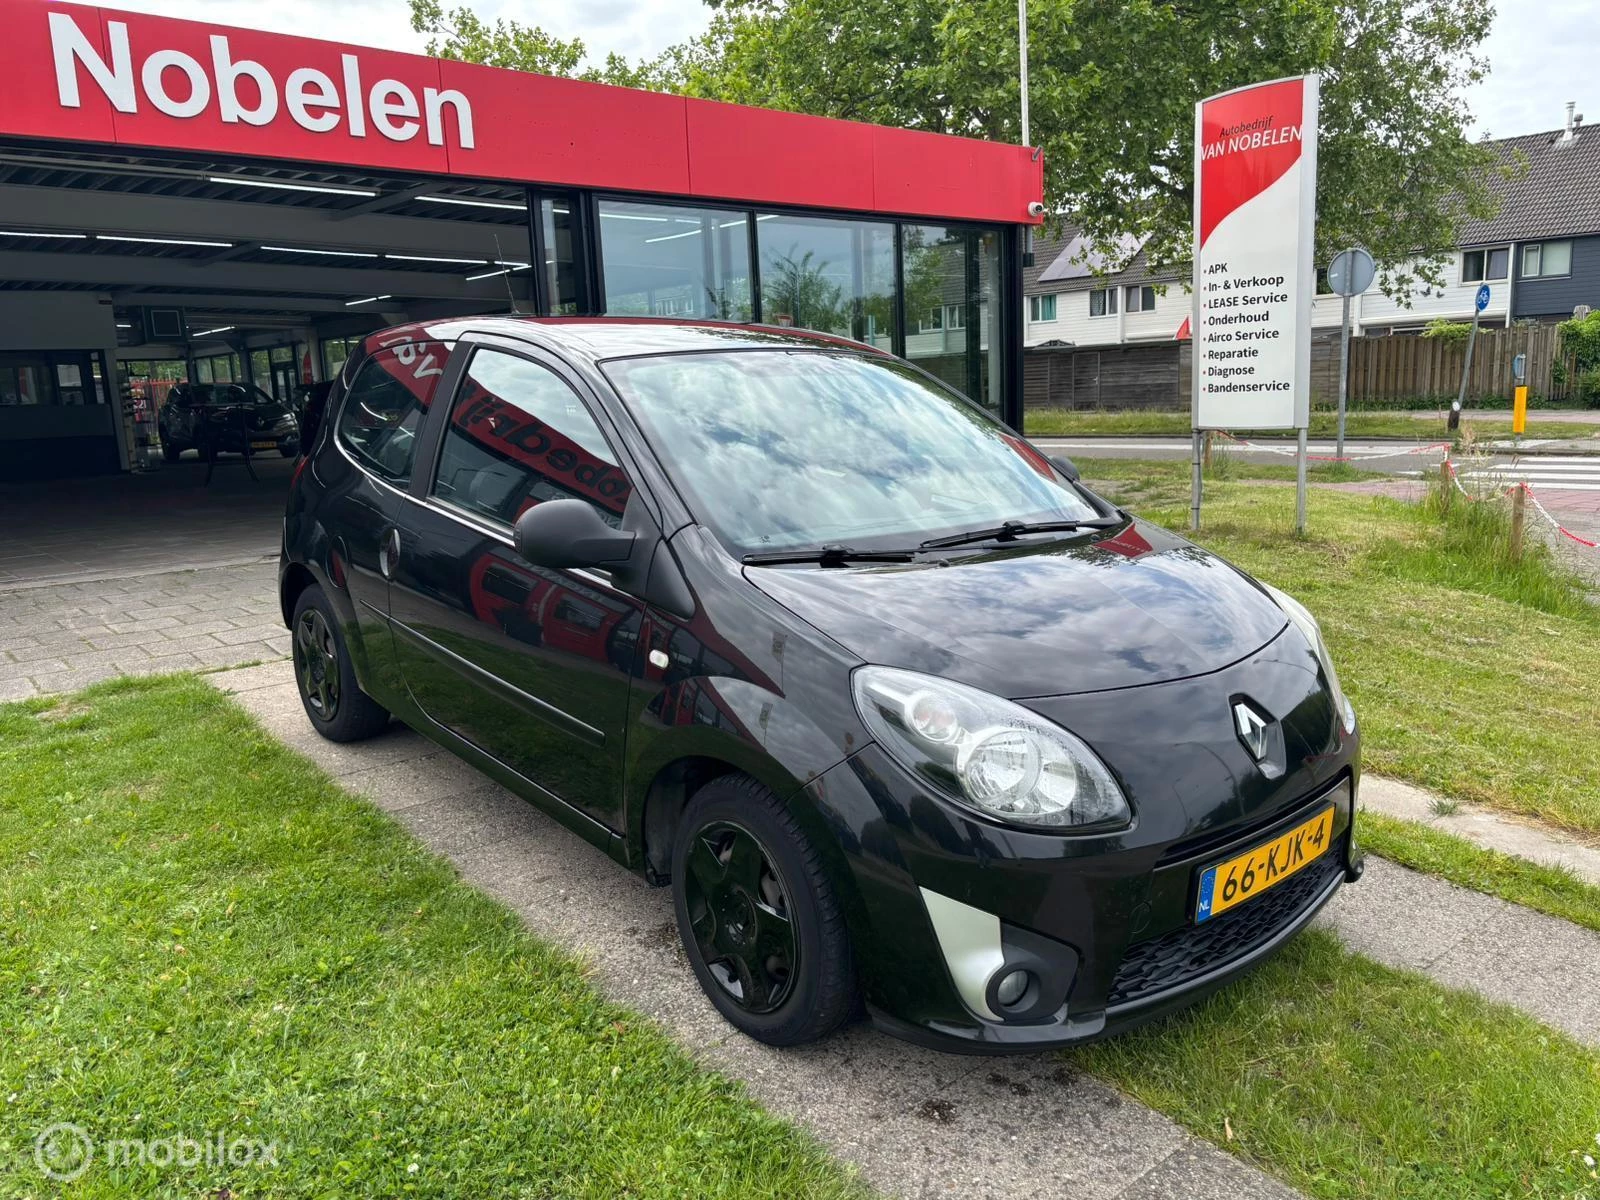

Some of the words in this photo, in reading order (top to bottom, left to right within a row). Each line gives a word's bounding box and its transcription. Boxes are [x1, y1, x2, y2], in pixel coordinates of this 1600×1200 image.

[48, 11, 476, 150] Nobelen
[1220, 115, 1274, 138] Autobedrijf
[1201, 141, 1225, 160] VAN
[1227, 124, 1303, 152] NOBELEN
[1208, 263, 1228, 275] APK
[1208, 282, 1221, 292] In-
[1223, 280, 1231, 290] &
[1233, 275, 1284, 289] Verkoop
[1208, 297, 1239, 309] LEASE
[1242, 292, 1288, 305] Service
[1208, 311, 1269, 326] Onderhoud
[1208, 332, 1232, 343] Airco
[1235, 328, 1280, 341] Service
[1208, 347, 1259, 362] Reparatie
[1208, 366, 1255, 379] Diagnose
[1208, 381, 1290, 393] Bandenservice
[1222, 817, 1325, 902] 66-KJK-4
[1198, 899, 1210, 913] NL
